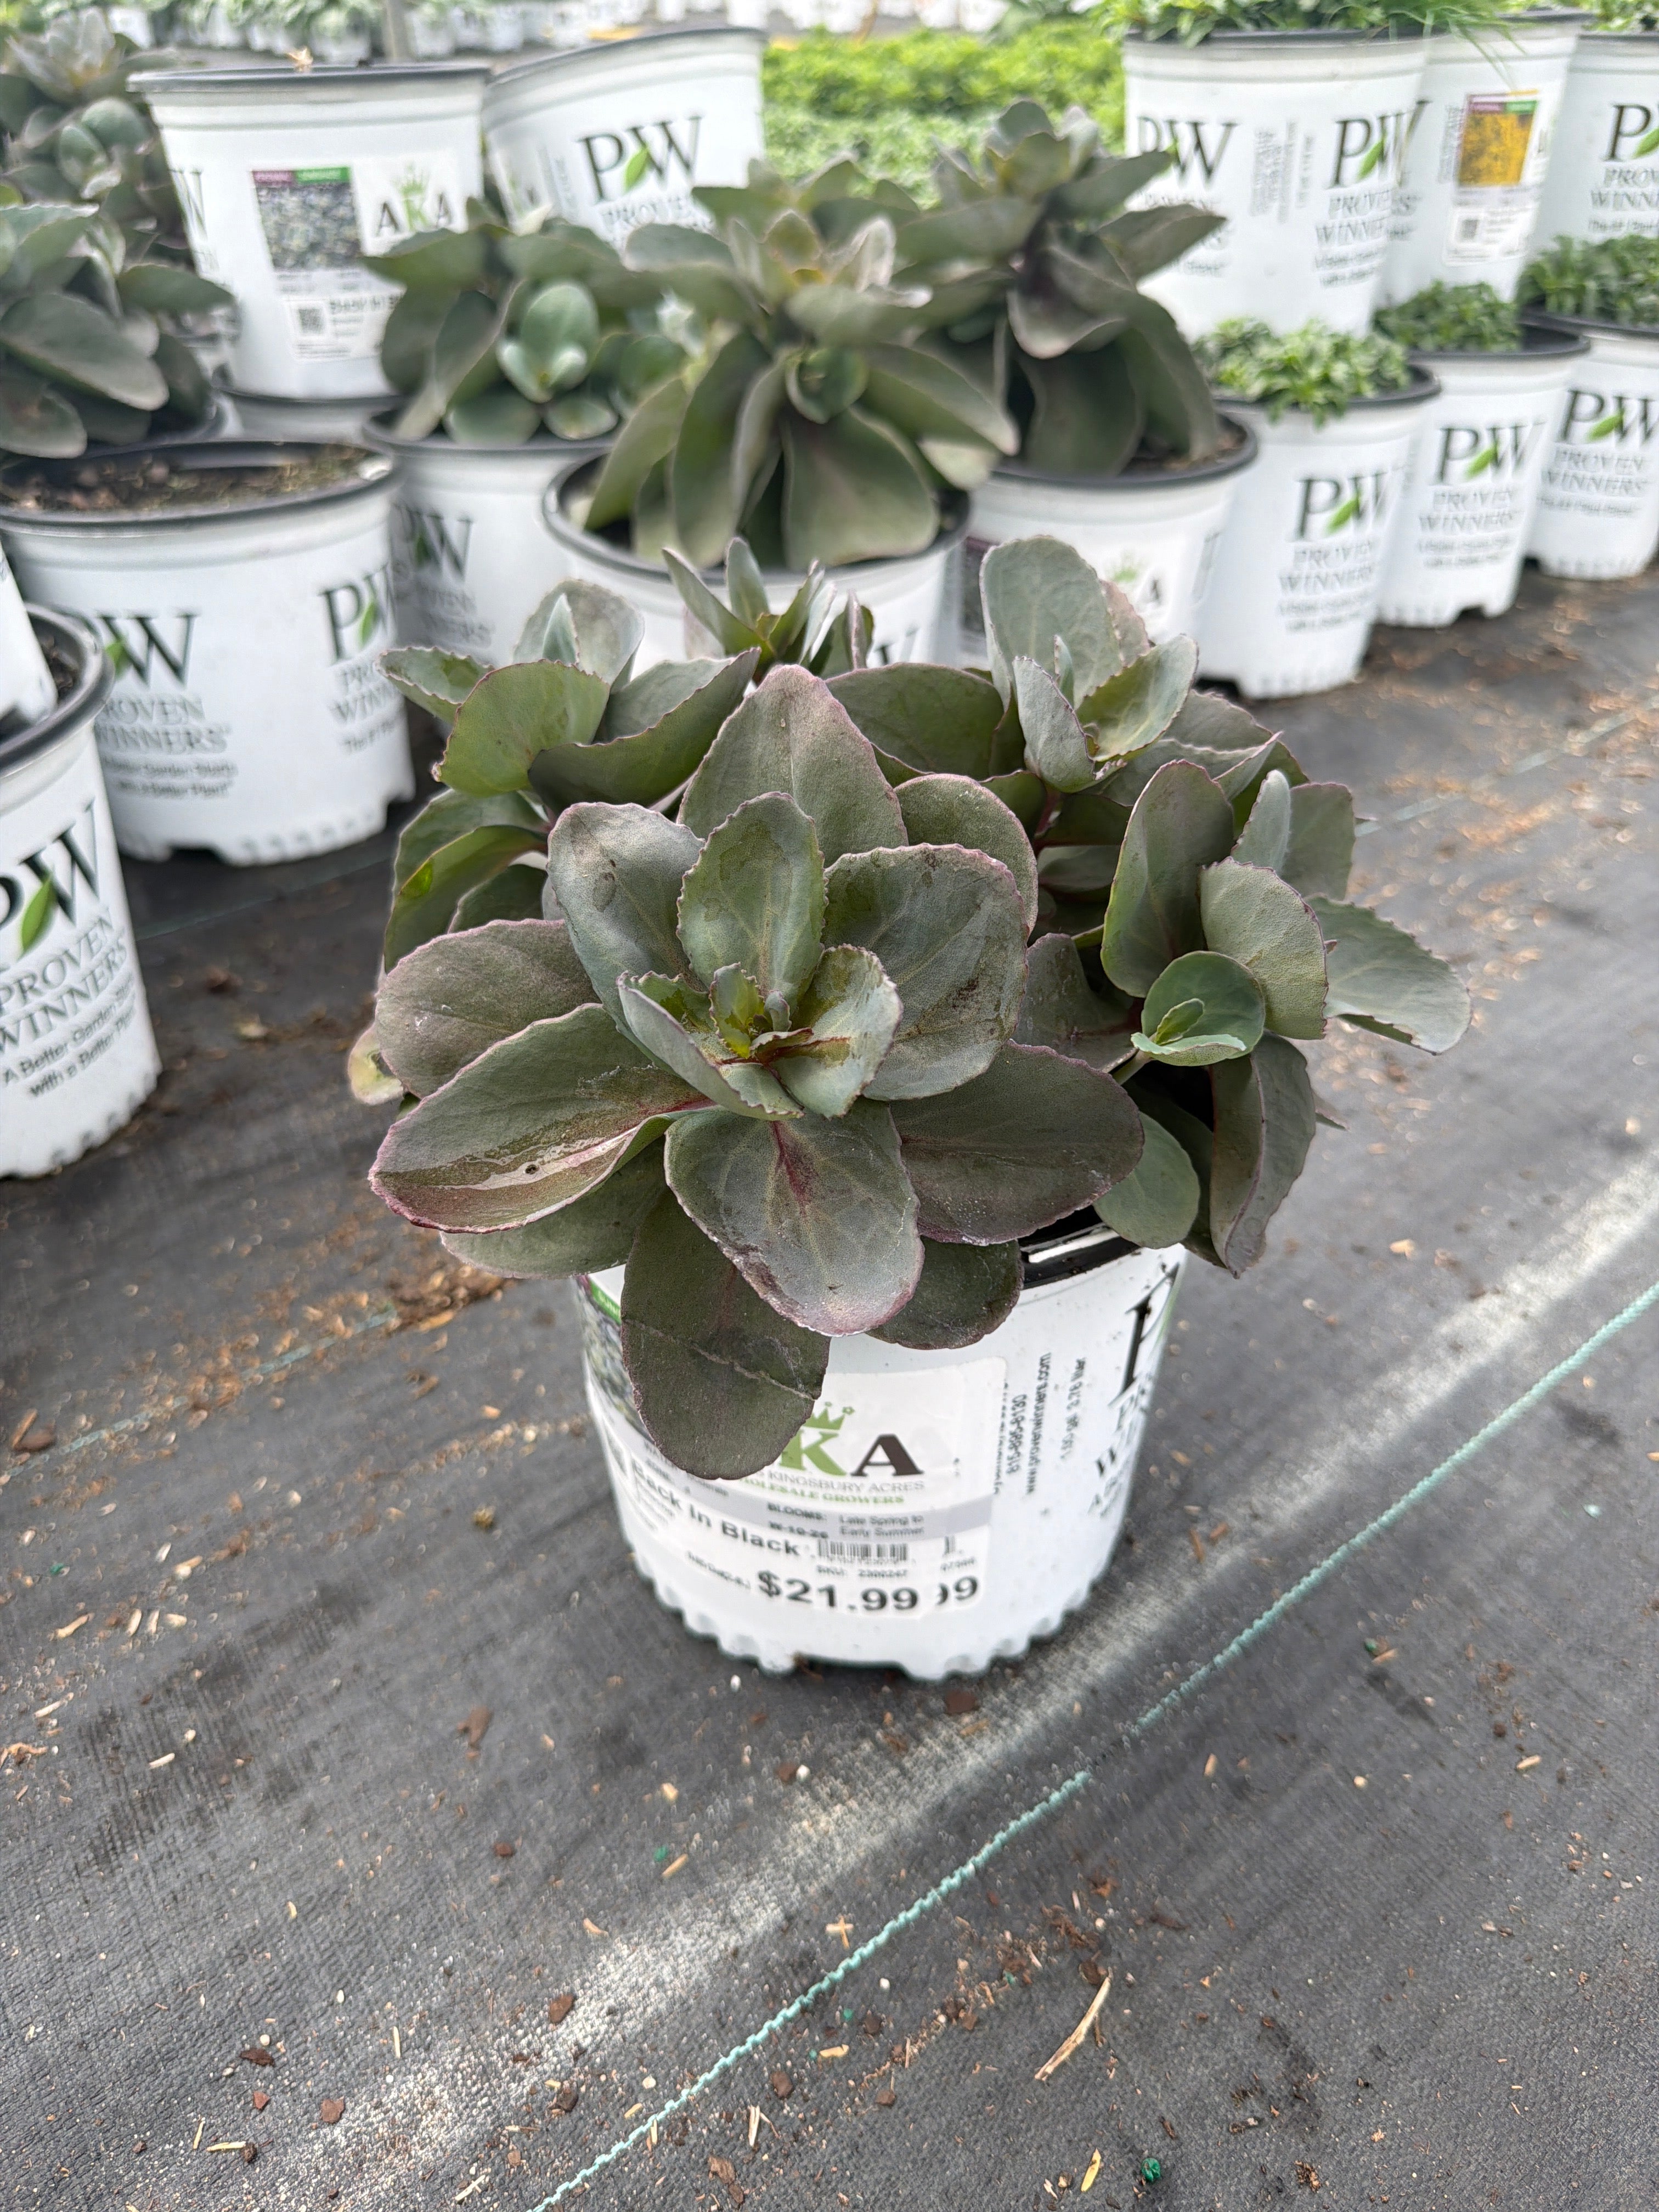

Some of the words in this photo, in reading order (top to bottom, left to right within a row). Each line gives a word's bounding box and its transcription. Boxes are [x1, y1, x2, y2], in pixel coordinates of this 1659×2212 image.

[572, 115, 702, 205] PW
[1554, 387, 1659, 445] PW
[1427, 421, 1545, 486] PW
[1286, 465, 1403, 543] PW
[95, 611, 202, 689] W
[780, 1430, 925, 1476] KA
[769, 1469, 865, 1492] KINGSBURY
[868, 1480, 925, 1493] ACRES
[822, 1493, 905, 1504] GROWERS
[689, 1504, 712, 1528] In
[721, 1519, 802, 1556] Black
[839, 1514, 866, 1526] Late
[870, 1514, 909, 1527] Spring
[758, 1570, 919, 1612] $21.99
